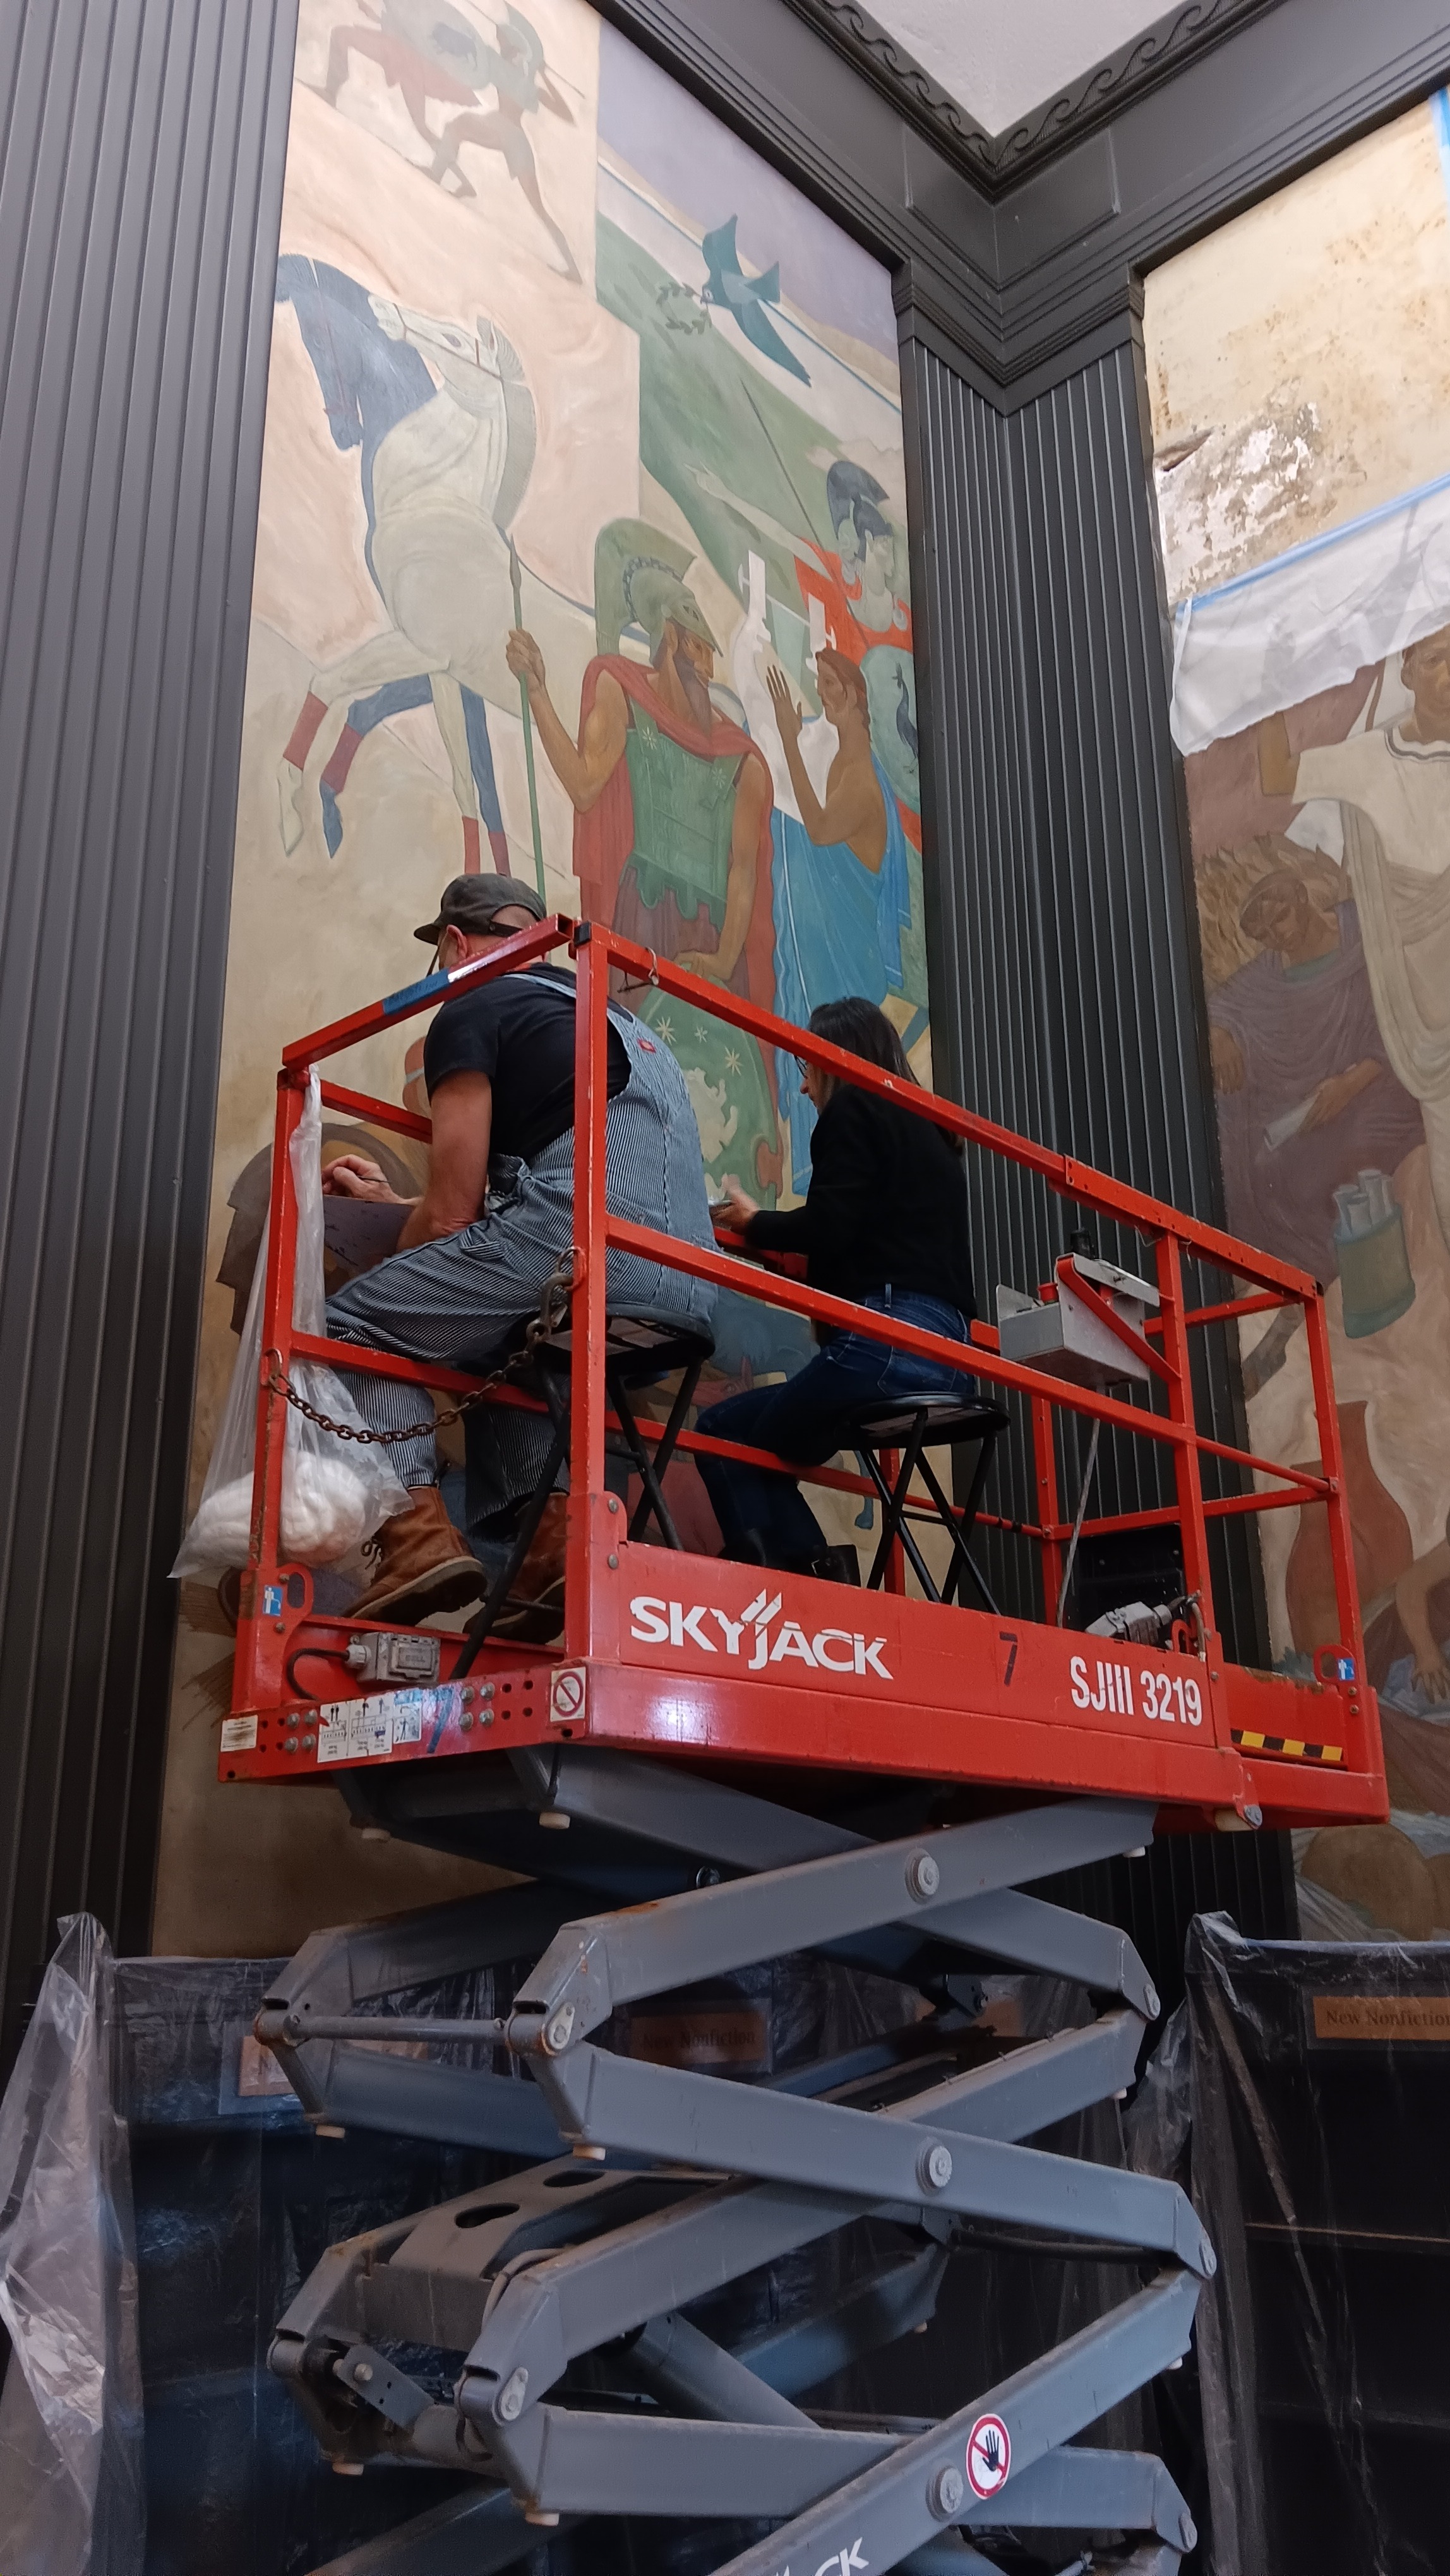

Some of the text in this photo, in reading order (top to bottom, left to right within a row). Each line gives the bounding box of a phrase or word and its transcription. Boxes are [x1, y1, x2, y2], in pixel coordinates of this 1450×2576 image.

[630, 1589, 894, 1679] SKYJACK
[999, 1631, 1018, 1686] 7
[1070, 1656, 1202, 1726] SJIII 3219
[1326, 2010, 1360, 2025] New
